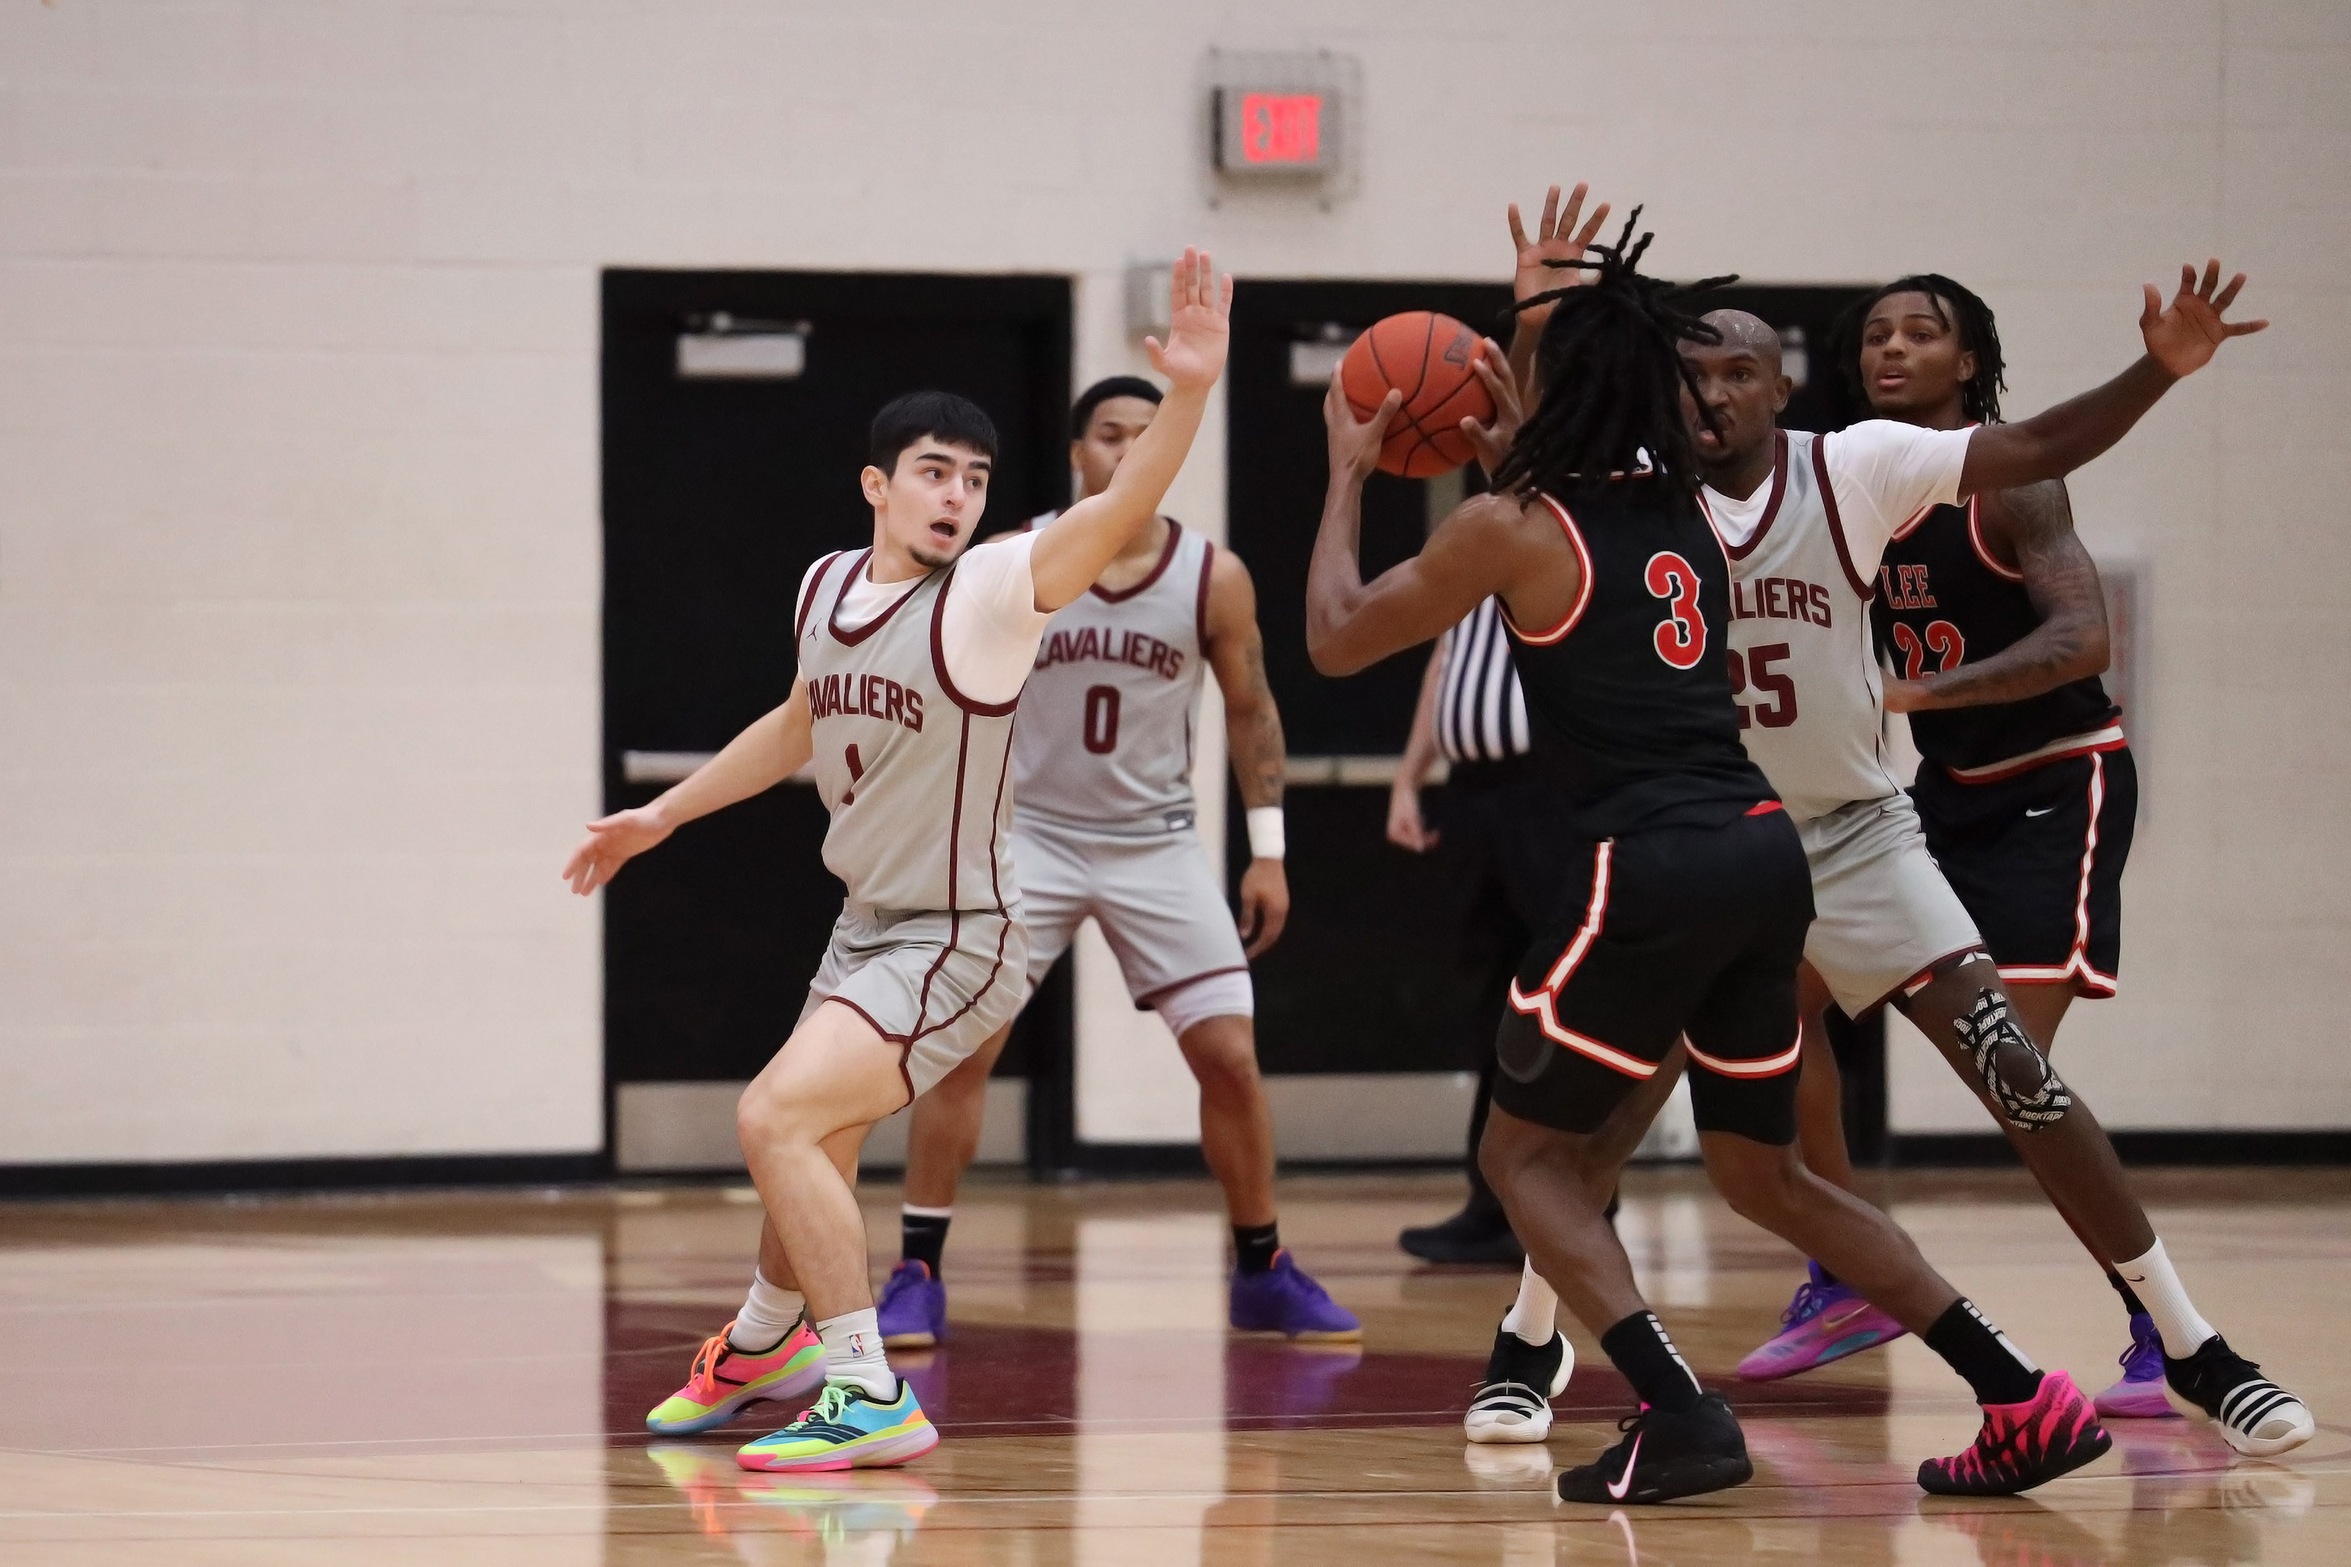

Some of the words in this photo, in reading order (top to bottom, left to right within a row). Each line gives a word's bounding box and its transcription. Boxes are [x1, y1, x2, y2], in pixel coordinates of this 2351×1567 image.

[1644, 551, 1709, 670] 3
[1728, 578, 1832, 629] LIERS
[1879, 564, 1938, 609] LEE
[805, 672, 924, 734] AVALIERS
[1084, 684, 1121, 755] 0
